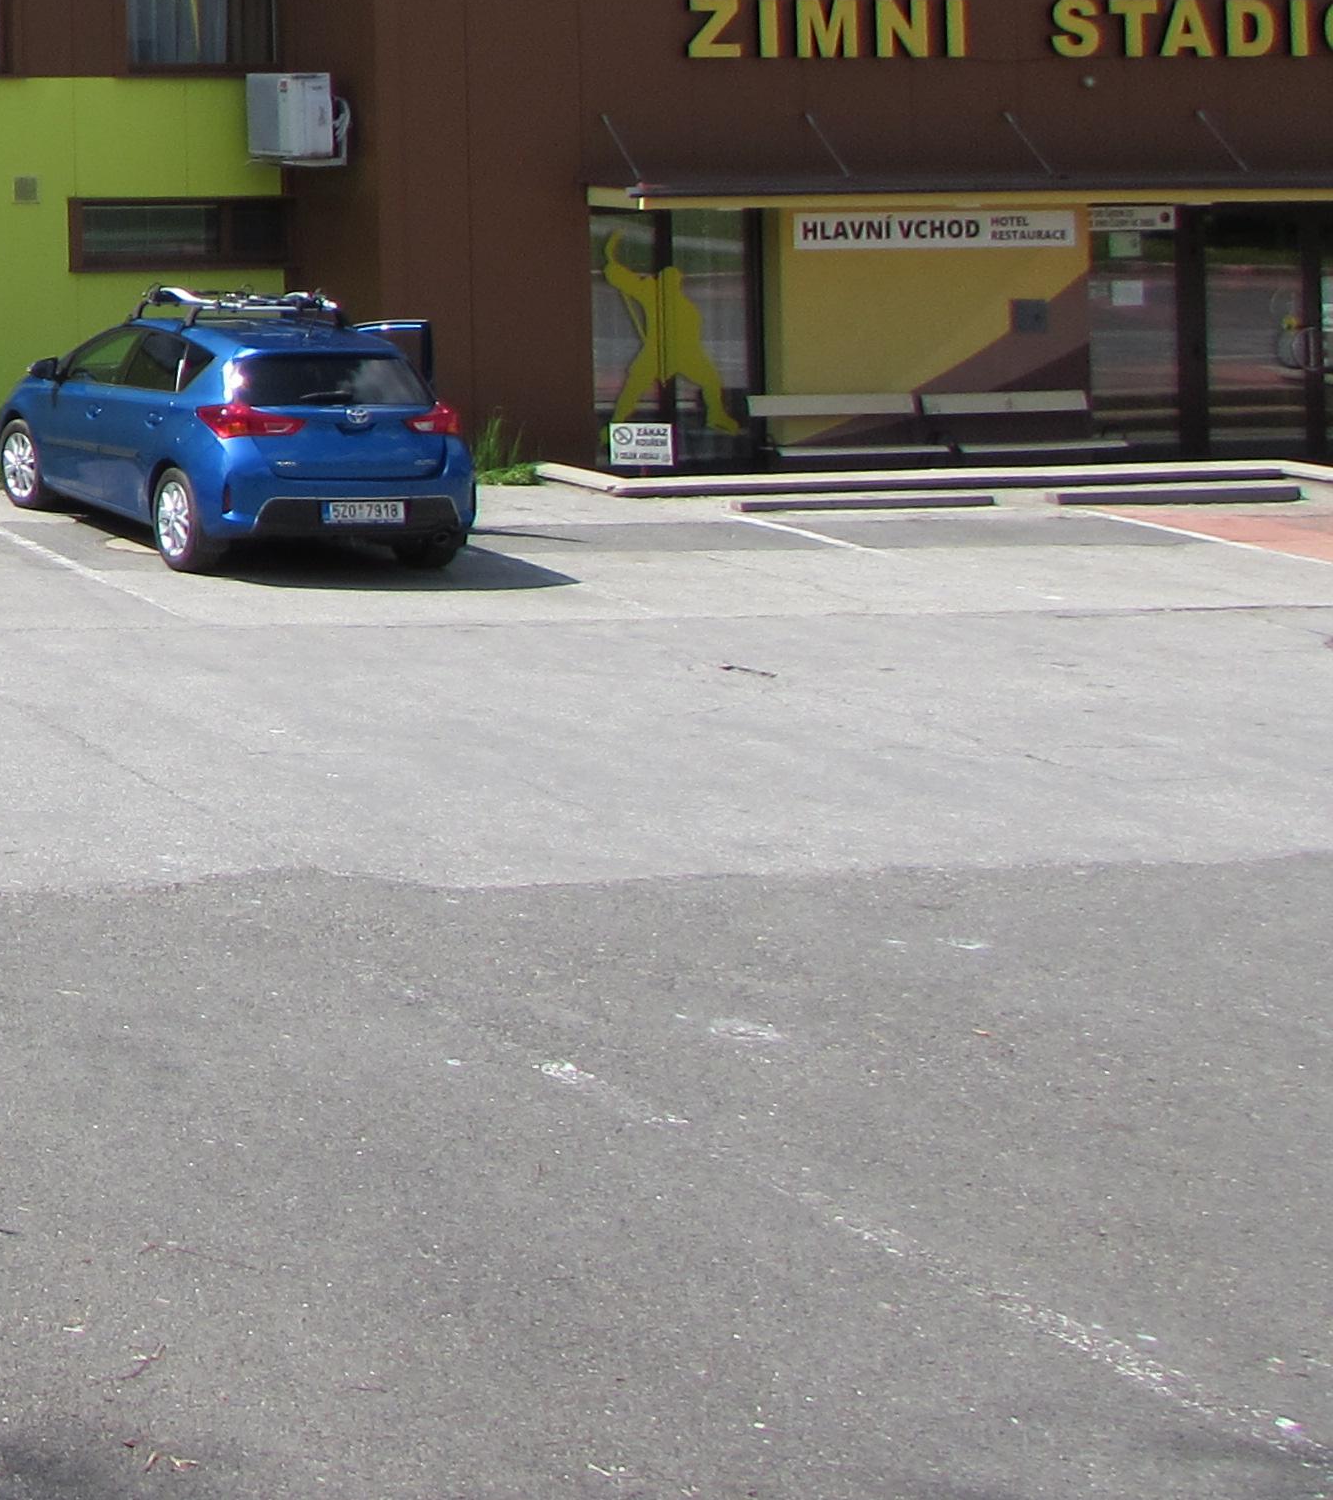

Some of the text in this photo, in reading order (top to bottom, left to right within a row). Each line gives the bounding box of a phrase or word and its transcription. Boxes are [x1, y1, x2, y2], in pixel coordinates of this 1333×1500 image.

[802, 215, 980, 240] HLAVNÍ VCHOD
[990, 215, 1030, 227] HOTEL
[990, 228, 1067, 241] RESTAURACE
